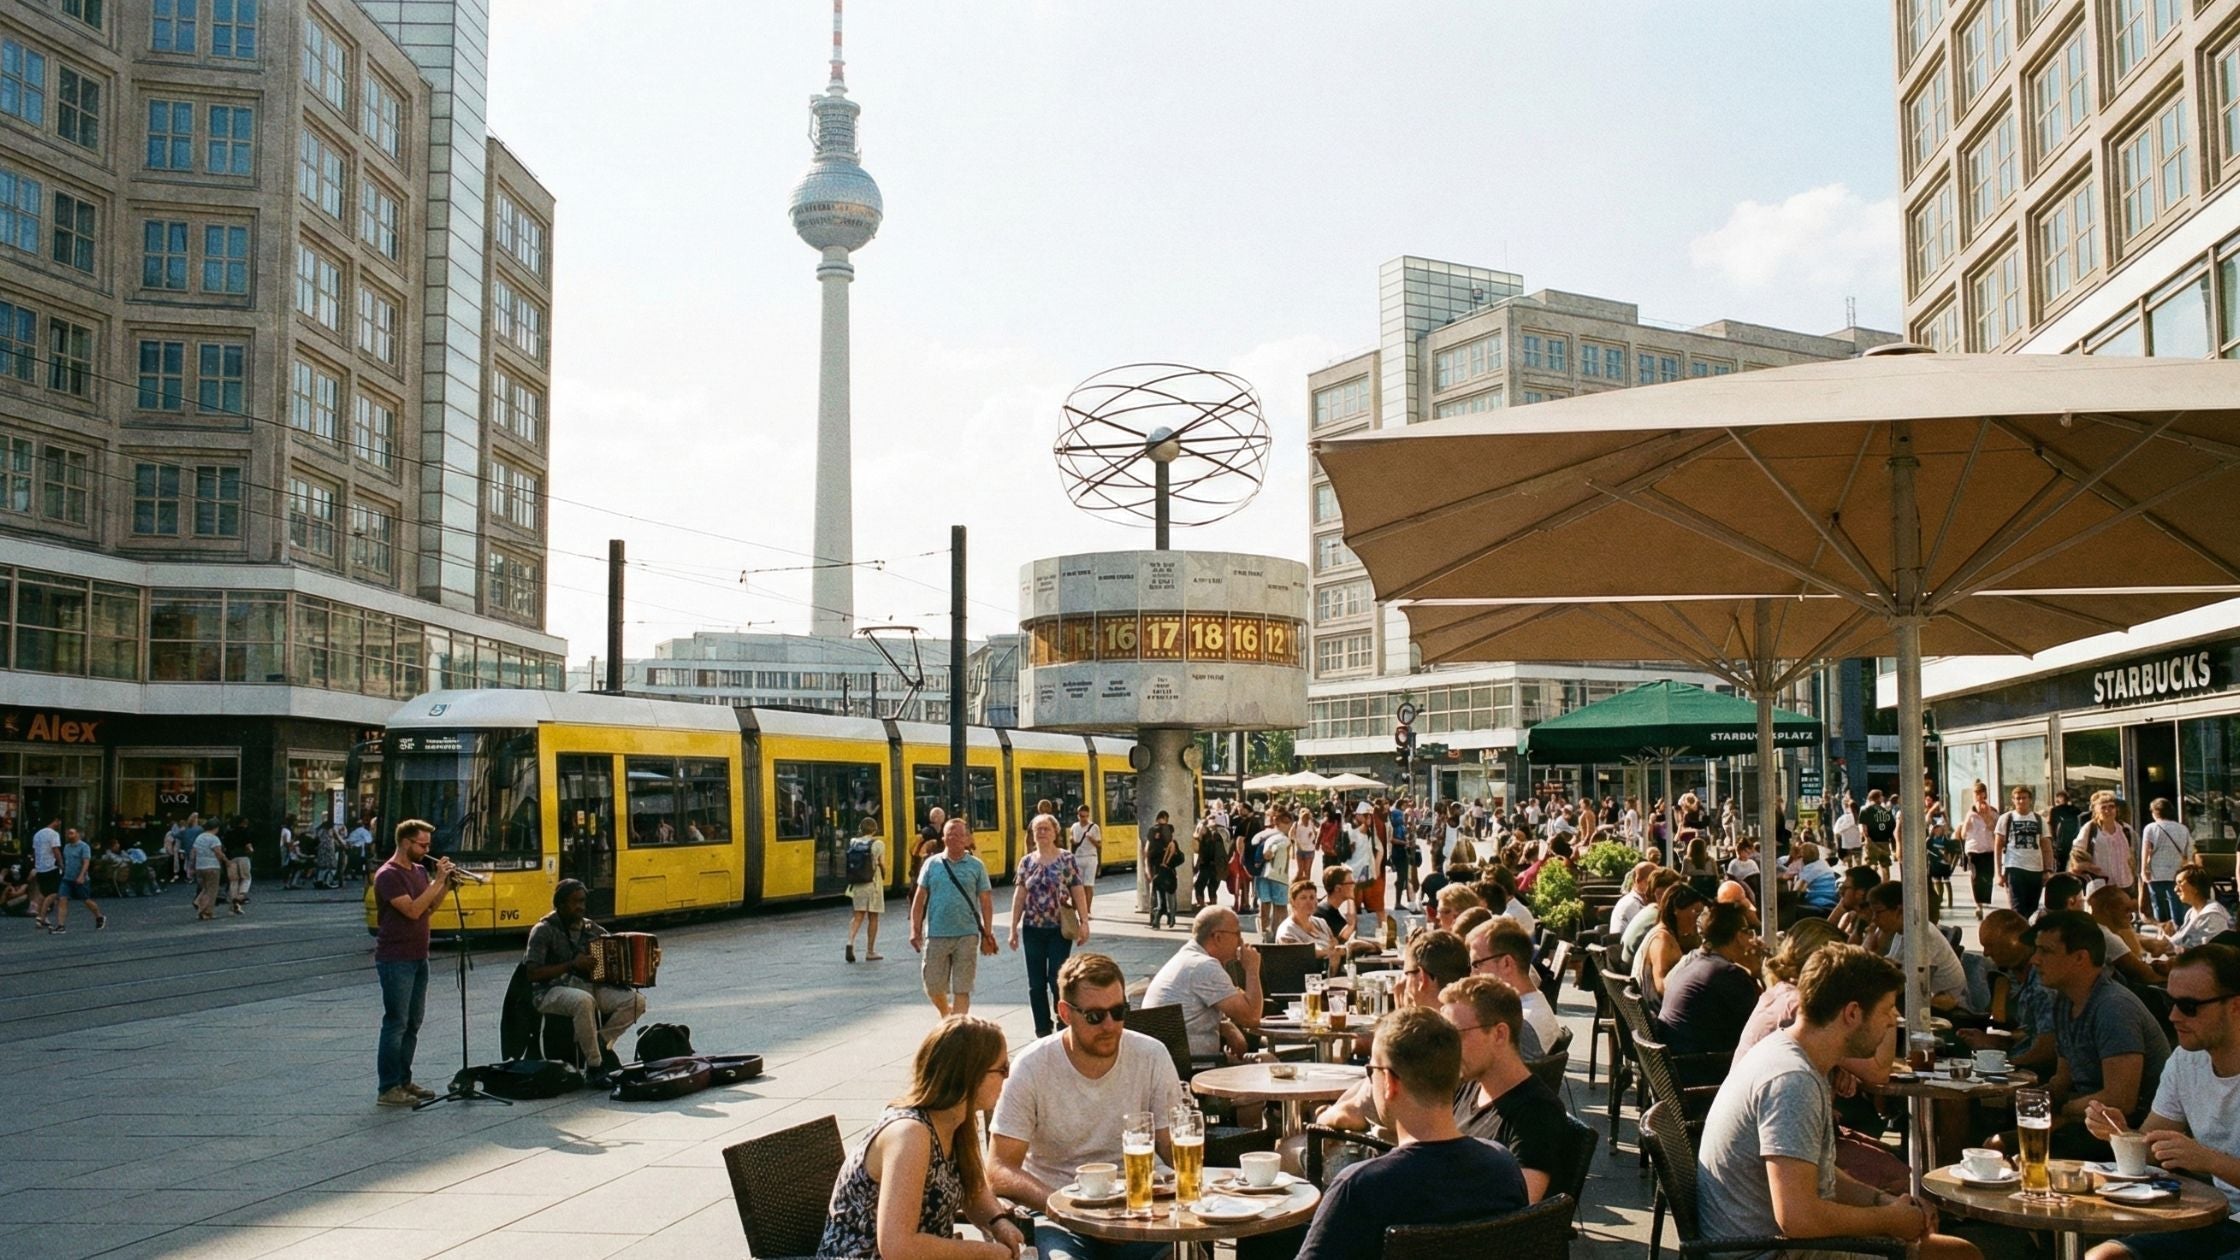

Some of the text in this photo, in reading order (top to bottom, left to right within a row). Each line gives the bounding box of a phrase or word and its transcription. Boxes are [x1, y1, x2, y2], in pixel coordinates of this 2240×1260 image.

[1105, 623, 1137, 650] 16
[1147, 622, 1180, 649] 17
[1192, 622, 1224, 650] 18
[1232, 624, 1258, 651] 16
[1265, 626, 1284, 654] 12
[2093, 651, 2211, 703] STARBUCKS
[26, 713, 98, 743] Alex
[500, 909, 520, 921] BVG
